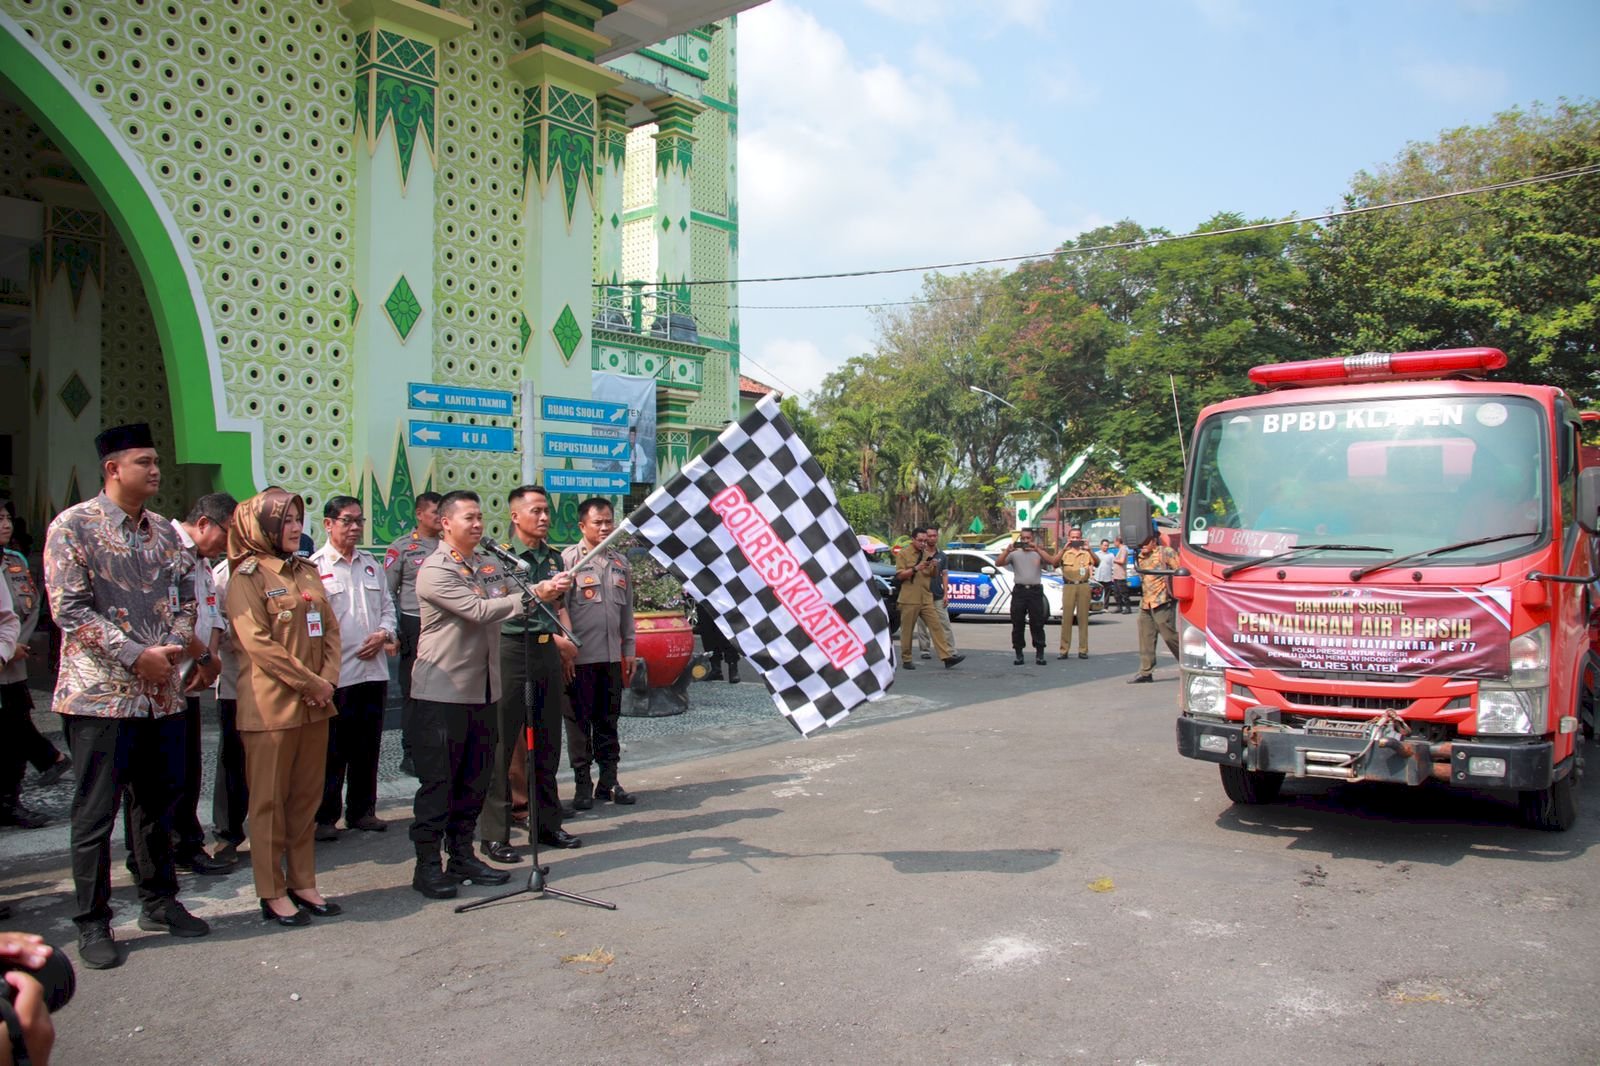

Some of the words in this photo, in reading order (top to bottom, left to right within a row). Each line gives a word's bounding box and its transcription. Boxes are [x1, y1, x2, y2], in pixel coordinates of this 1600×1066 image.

[478, 397, 507, 409] TAKMIR
[547, 404, 575, 416] RUANG
[576, 407, 605, 419] SHOLAT
[1263, 410, 1337, 434] BPBD
[1345, 404, 1464, 429] KLATEN
[548, 440, 609, 455] PERPUSTAKAAN
[714, 489, 796, 583] POLRES
[782, 578, 860, 664] KLATEN
[942, 583, 976, 594] OLISI
[1295, 600, 1354, 614] BANTUAN
[1358, 600, 1406, 615] SOSIAL
[1238, 612, 1354, 636] PENYALURAN
[1361, 616, 1393, 637] AIR
[1400, 617, 1472, 639] BERSIH
[1233, 633, 1269, 644] DALAM
[1273, 635, 1315, 646] RANGKA
[1320, 637, 1346, 647] HARI
[1352, 638, 1435, 650] BHAYANGKARA
[1461, 642, 1477, 652] 77
[1347, 649, 1375, 657] UNTUK
[1300, 660, 1349, 670] POLRES
[1352, 663, 1399, 673] KLATEN
